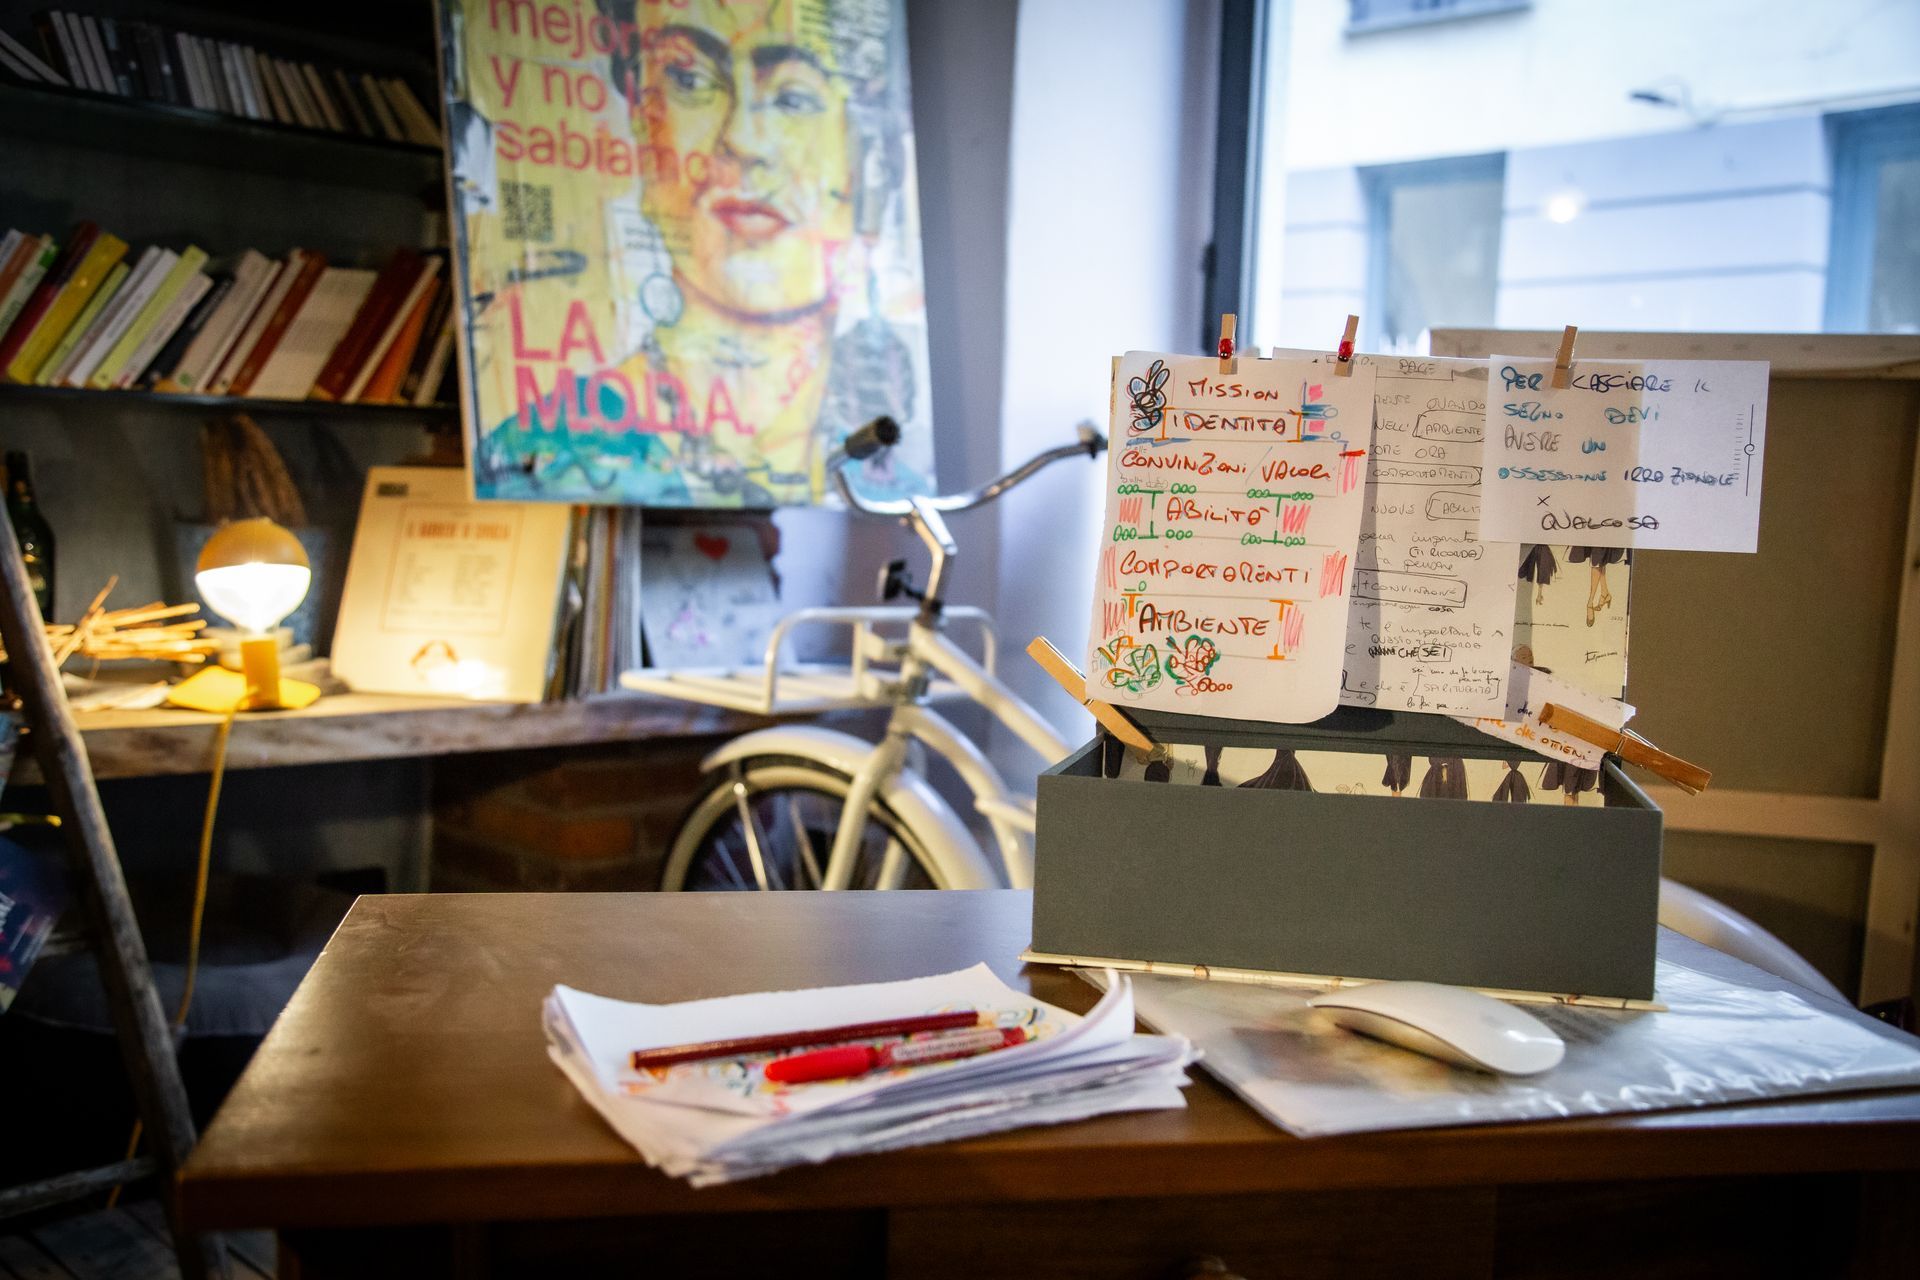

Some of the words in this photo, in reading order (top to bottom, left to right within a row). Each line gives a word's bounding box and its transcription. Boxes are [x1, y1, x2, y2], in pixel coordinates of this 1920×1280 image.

[490, 54, 522, 109] y
[543, 65, 607, 112] no
[508, 293, 606, 364] LA
[1187, 376, 1279, 401] MISSION
[1500, 366, 1543, 392] PER
[1603, 404, 1659, 425] DEVI
[1415, 446, 1446, 459] ORA
[1581, 436, 1607, 454] UN
[1541, 508, 1660, 532] QUALCOSA
[1120, 550, 1312, 585] COMPORTAMENTI
[1138, 602, 1271, 637] AMBIENTE
